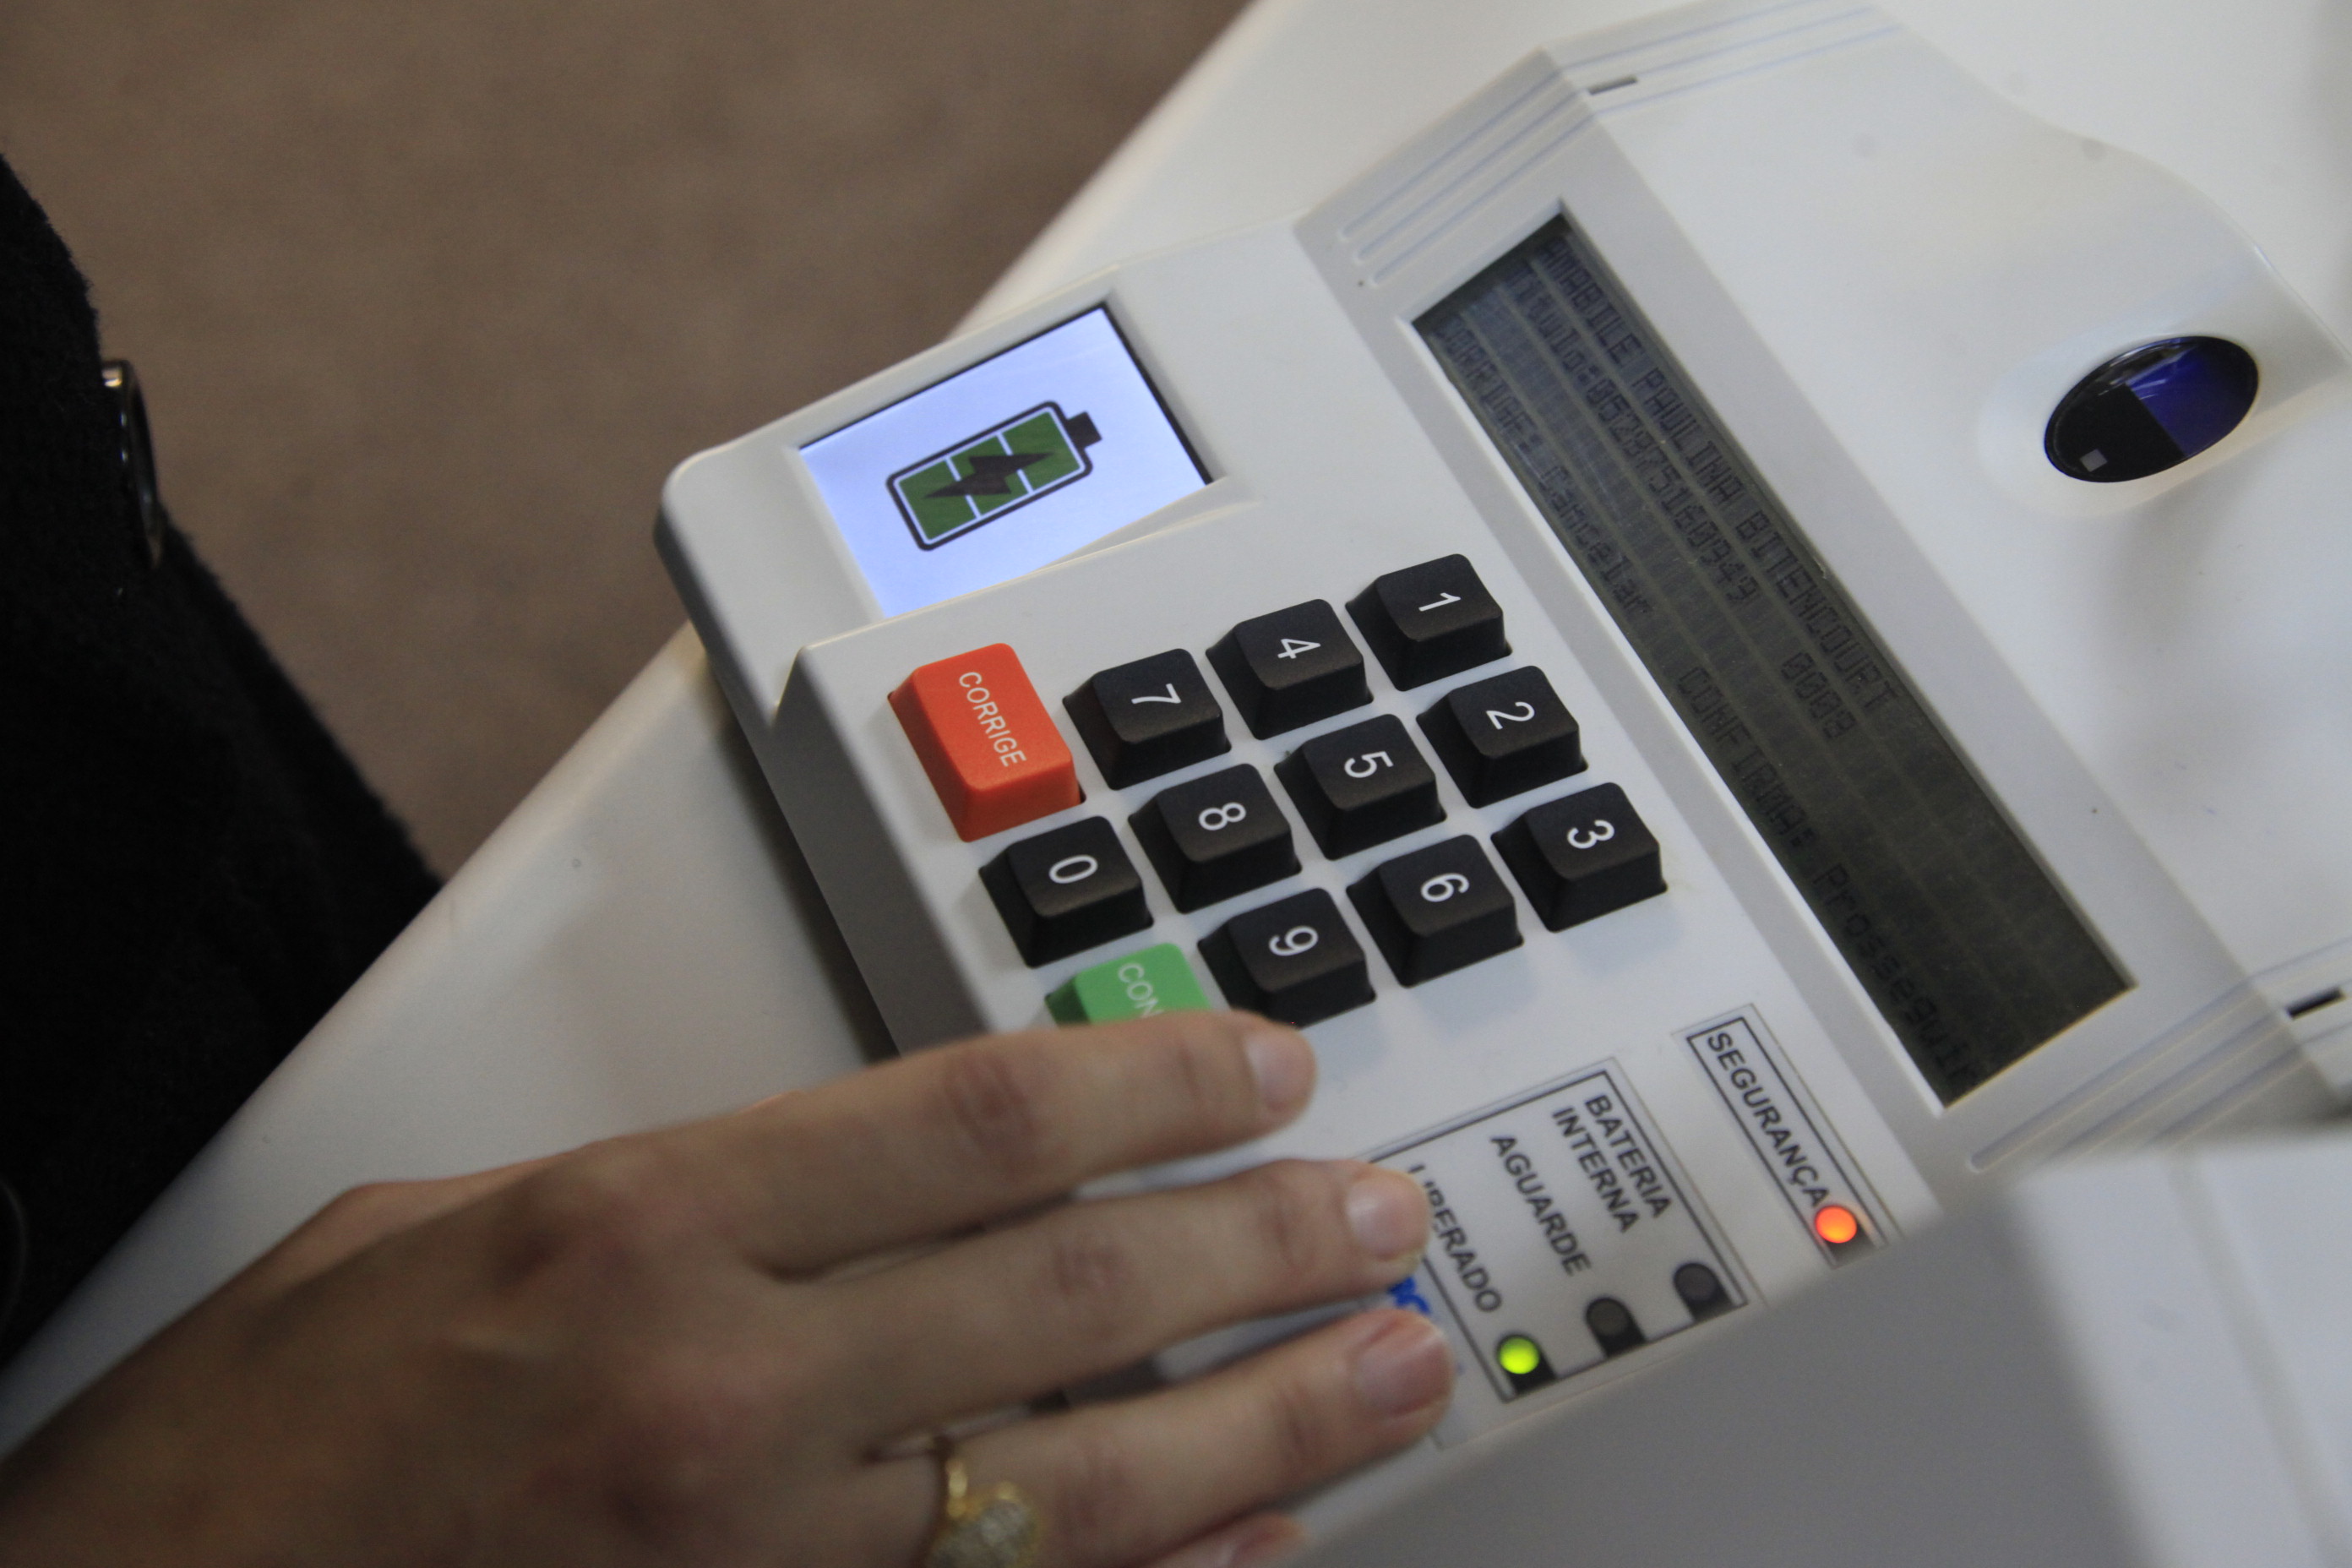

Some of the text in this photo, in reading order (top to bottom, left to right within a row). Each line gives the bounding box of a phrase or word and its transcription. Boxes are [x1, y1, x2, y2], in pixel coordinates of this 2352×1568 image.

[1631, 366, 1745, 507] PAULINA
[1734, 509, 1898, 717] BITENCOURT
[1418, 592, 1462, 612] 1
[1277, 637, 1320, 659] 4
[1534, 460, 1660, 624] Cancelar
[1673, 662, 1819, 854] CONFIRMA:
[1131, 683, 1182, 705] 7
[959, 672, 1026, 767] CORRIGE
[1486, 701, 1535, 730] 2
[1344, 750, 1393, 779] 5
[1199, 802, 1246, 831] 8
[1567, 819, 1614, 850] 3
[1049, 854, 1098, 885] 0
[1420, 873, 1469, 902] 6
[1269, 925, 1318, 956] 9
[1707, 1029, 1832, 1206] SEGURANÇA
[1552, 1105, 1641, 1234] INTERNA
[1584, 1094, 1673, 1219] BATERIA
[1490, 1133, 1592, 1277] AGUARDE
[1408, 1165, 1502, 1313] BERADO
